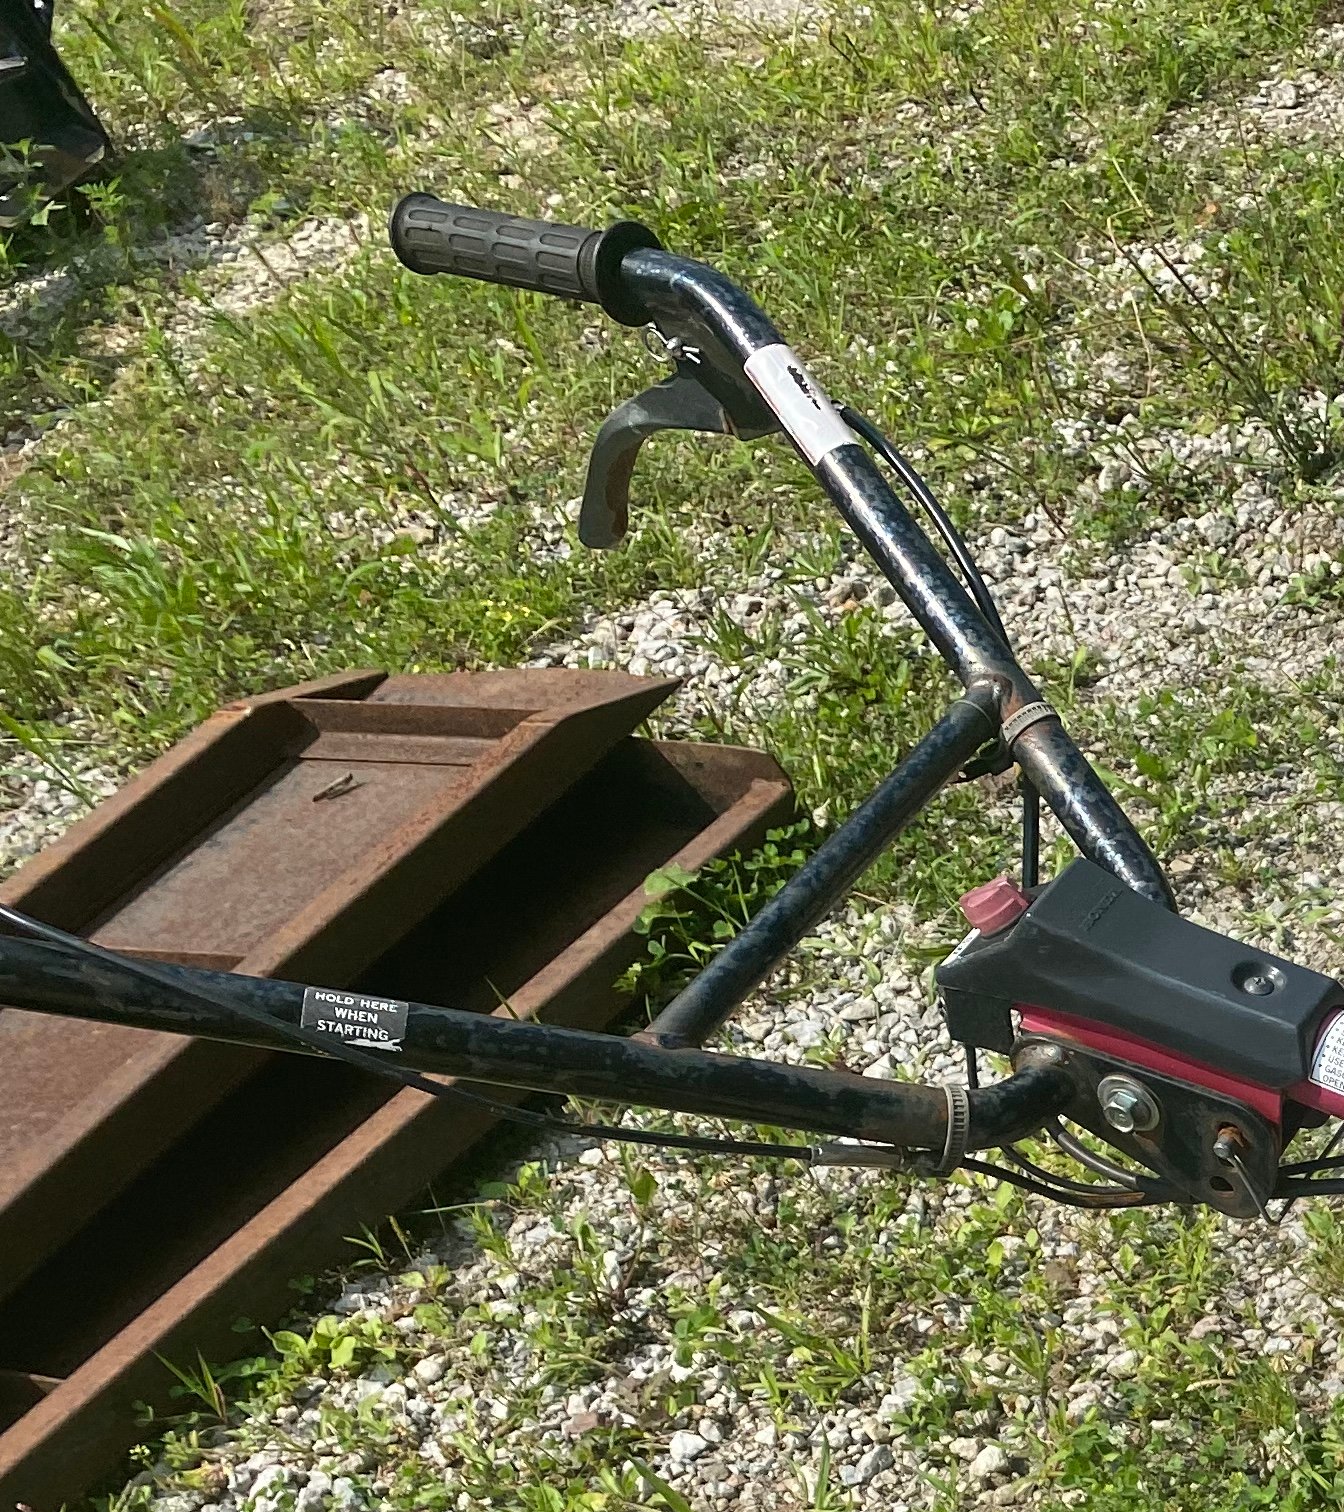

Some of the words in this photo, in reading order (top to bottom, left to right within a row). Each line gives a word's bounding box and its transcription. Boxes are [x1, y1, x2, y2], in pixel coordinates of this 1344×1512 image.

[315, 991, 354, 1005] HOLD
[360, 998, 398, 1013] HERE
[334, 1006, 378, 1024] WHEN
[317, 1019, 389, 1041] STARTING
[1326, 1054, 1344, 1067] USE
